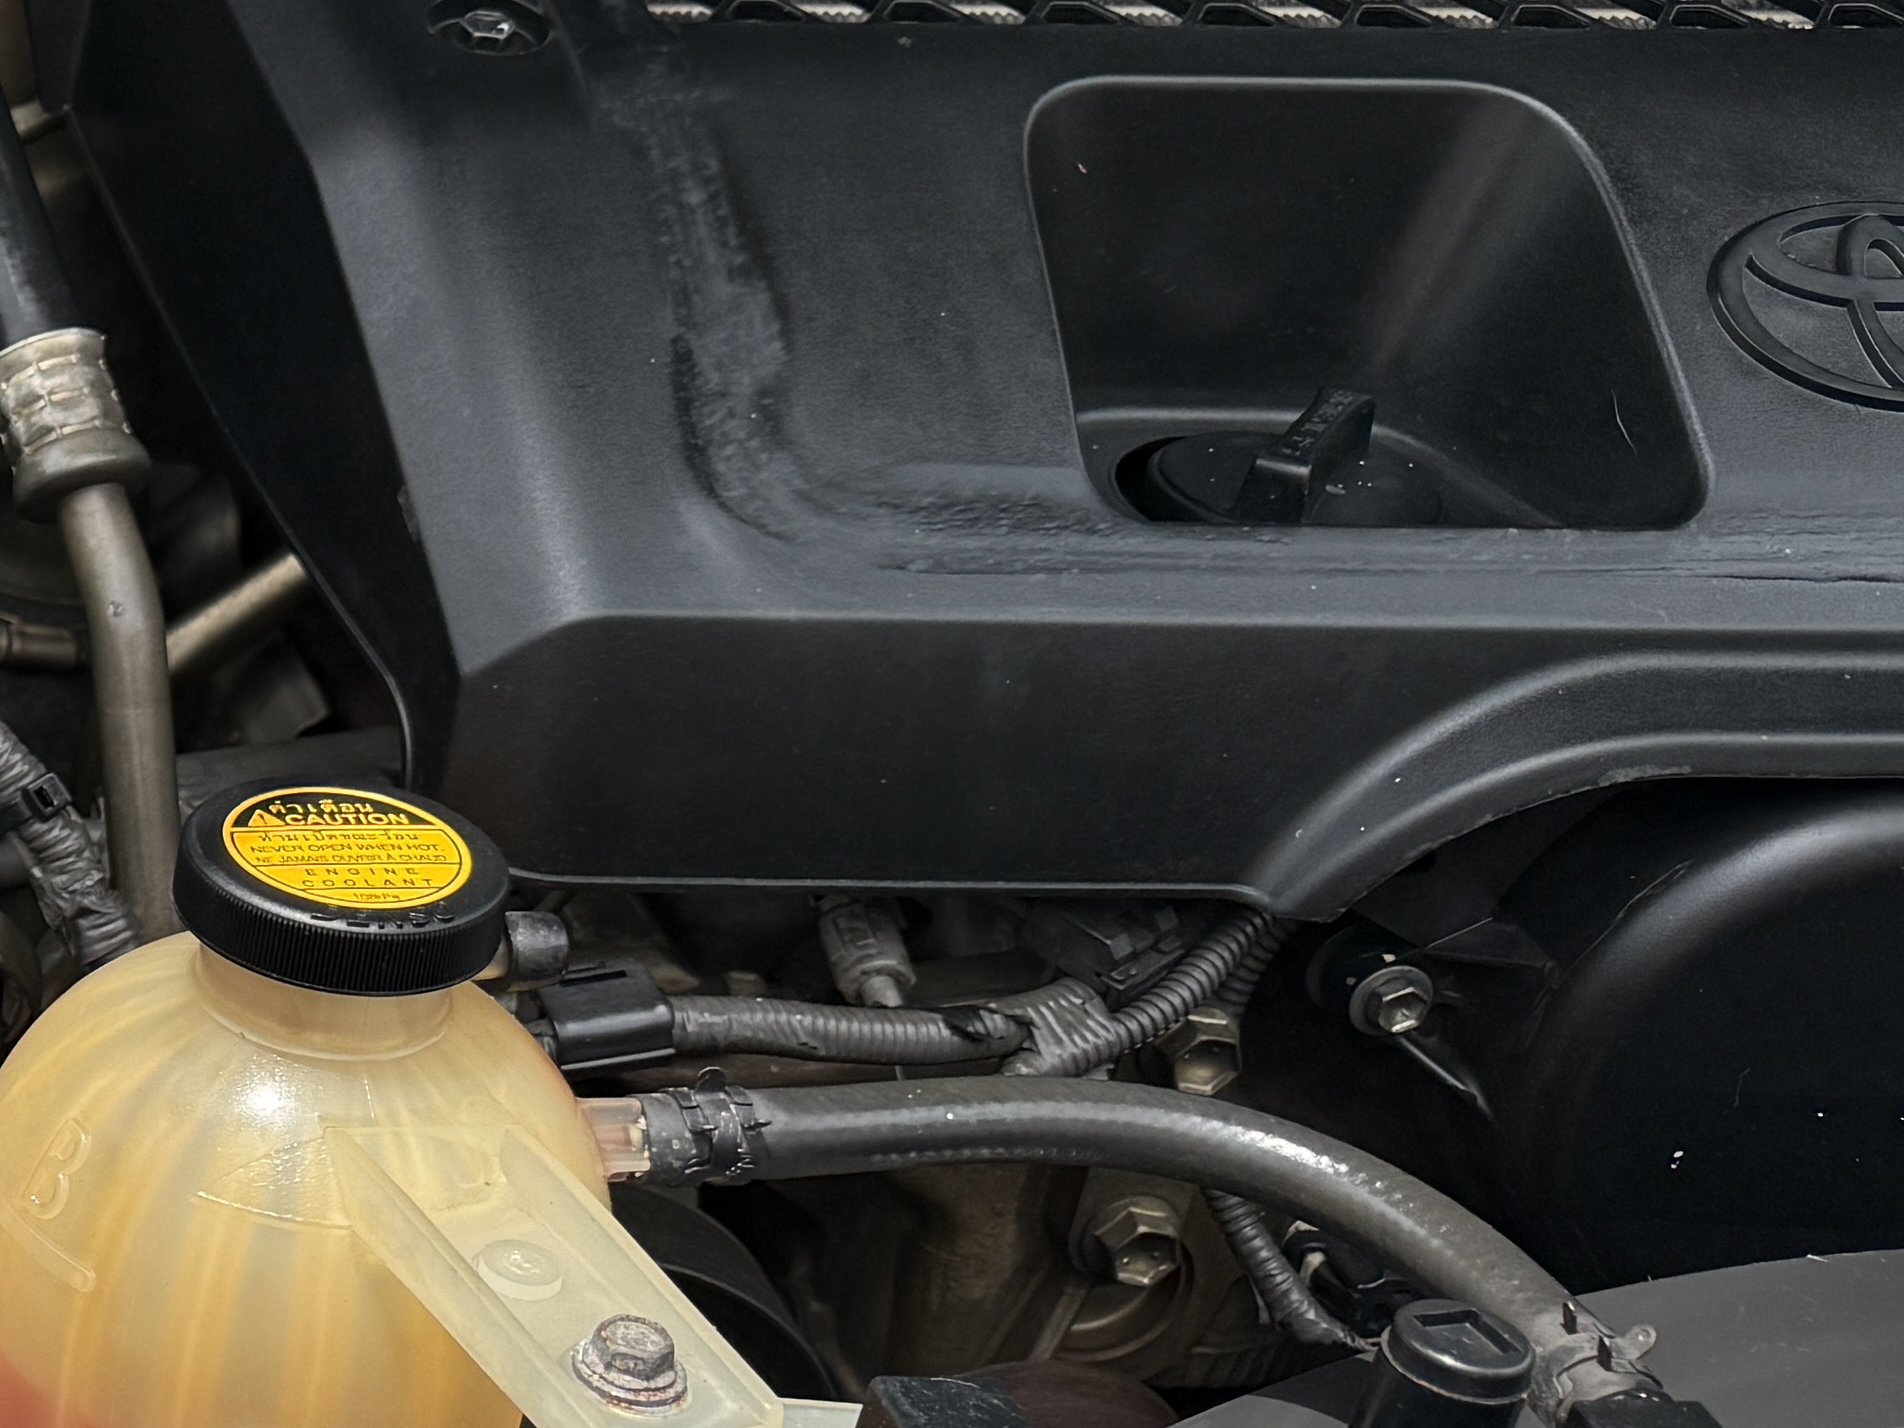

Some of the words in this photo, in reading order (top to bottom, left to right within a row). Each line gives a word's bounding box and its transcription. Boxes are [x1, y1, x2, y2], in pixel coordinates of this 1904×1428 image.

[285, 813, 409, 825] CAUTION
[250, 845, 305, 853] NEVER
[308, 844, 352, 852] OPEN
[357, 843, 402, 852] WHEN
[305, 868, 419, 876] ENGINE
[302, 878, 433, 887] COOLANT
[310, 902, 455, 930] DENSO
[24, 1117, 91, 1219] B
